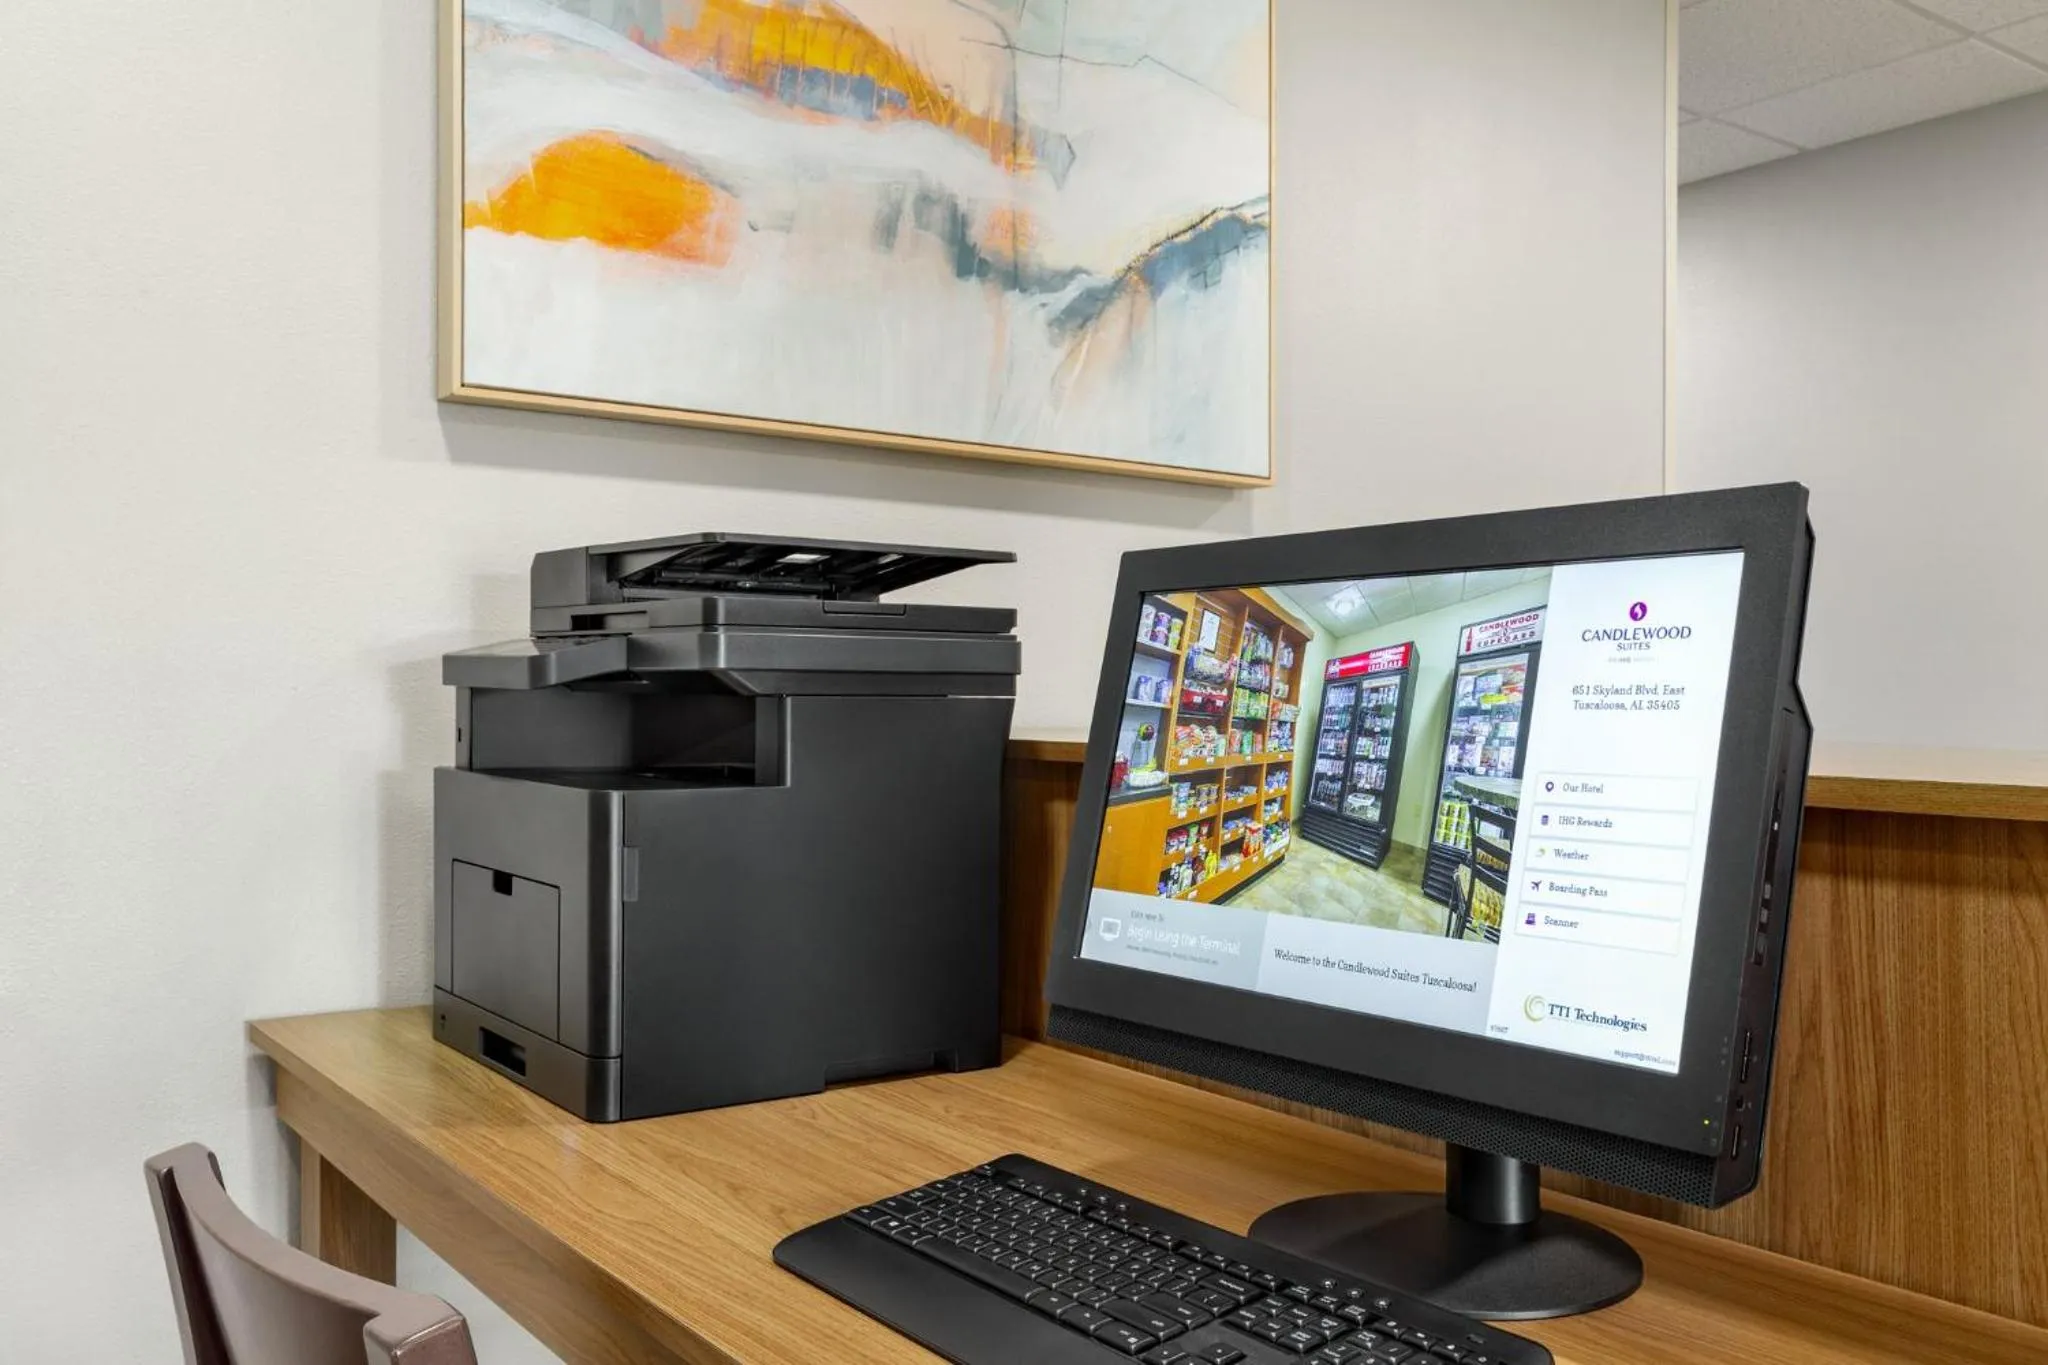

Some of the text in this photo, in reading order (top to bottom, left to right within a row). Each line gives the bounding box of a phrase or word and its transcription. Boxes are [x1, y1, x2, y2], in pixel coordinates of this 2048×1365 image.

[1581, 626, 1692, 642] CANDLEWOOD
[1616, 642, 1651, 651] SUITES
[1572, 684, 1590, 696] 651
[1592, 684, 1633, 697] Skyland
[1662, 684, 1685, 696] East
[1630, 700, 1646, 710] AL
[1647, 699, 1680, 711] 35405
[1562, 783, 1604, 794] Our Hotel
[1559, 815, 1613, 829] IHG Rewards
[1554, 848, 1590, 861] Weather
[1548, 882, 1608, 897] Boarding Pass
[1544, 915, 1580, 929] Scanner
[1127, 925, 1152, 942] Begin
[1274, 948, 1478, 993] Welcome to the Candlewood Suites Tuscaloosa!
[1548, 1003, 1648, 1032] TTI Technologies
